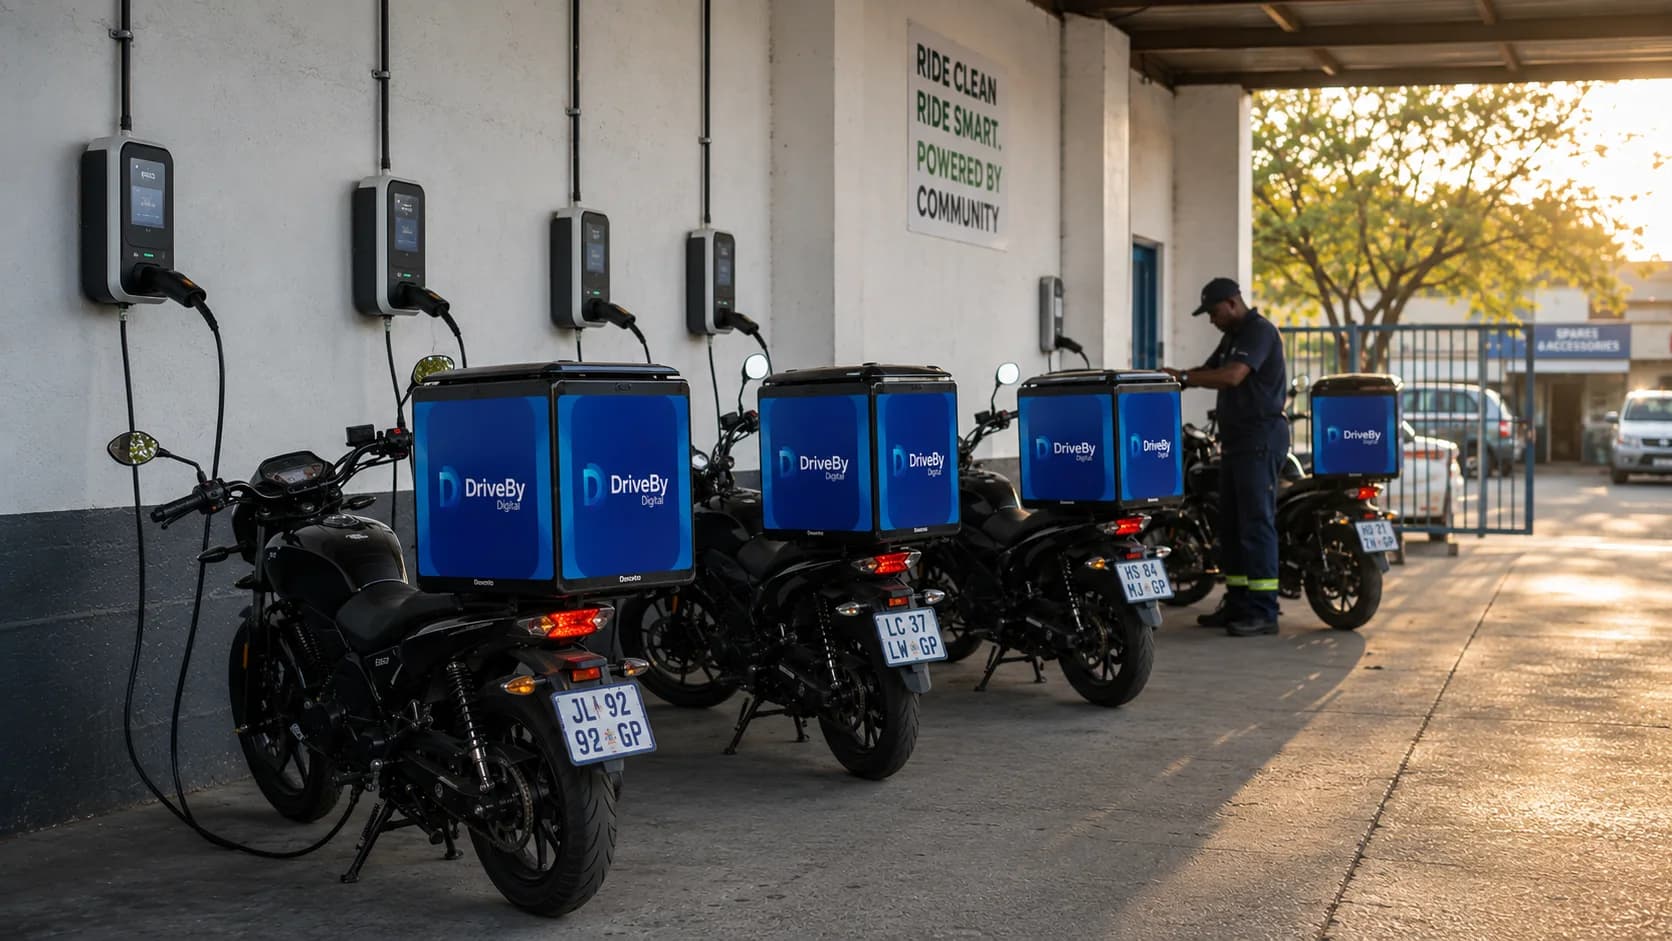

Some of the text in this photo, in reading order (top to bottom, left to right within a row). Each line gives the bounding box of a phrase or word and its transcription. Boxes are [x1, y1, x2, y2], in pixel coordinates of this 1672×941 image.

[917, 43, 997, 106] RIDE CLEAN
[917, 89, 1002, 152] RIDE SMART.
[917, 140, 1002, 193] POWERED BY
[917, 185, 1000, 233] COMMUNITY
[1556, 328, 1599, 340] SPARES
[1343, 430, 1381, 441] DriveBy
[1053, 442, 1096, 457] DriveBy
[1143, 439, 1171, 453] DriveBy
[800, 455, 849, 474] DriveBy
[909, 452, 945, 469] DriveBy
[825, 472, 845, 482] Digital
[927, 467, 942, 478] Digital
[465, 478, 526, 502] DriveBy
[610, 473, 669, 497] DriveBy
[496, 499, 521, 513] Digital
[641, 495, 664, 508] Digital
[1124, 563, 1158, 580] HS 84
[1127, 580, 1166, 598] MJ GP
[885, 614, 926, 637] LC 37
[888, 635, 938, 660] LW GP
[571, 691, 632, 724] JL 92
[575, 720, 642, 755] 92 GP
